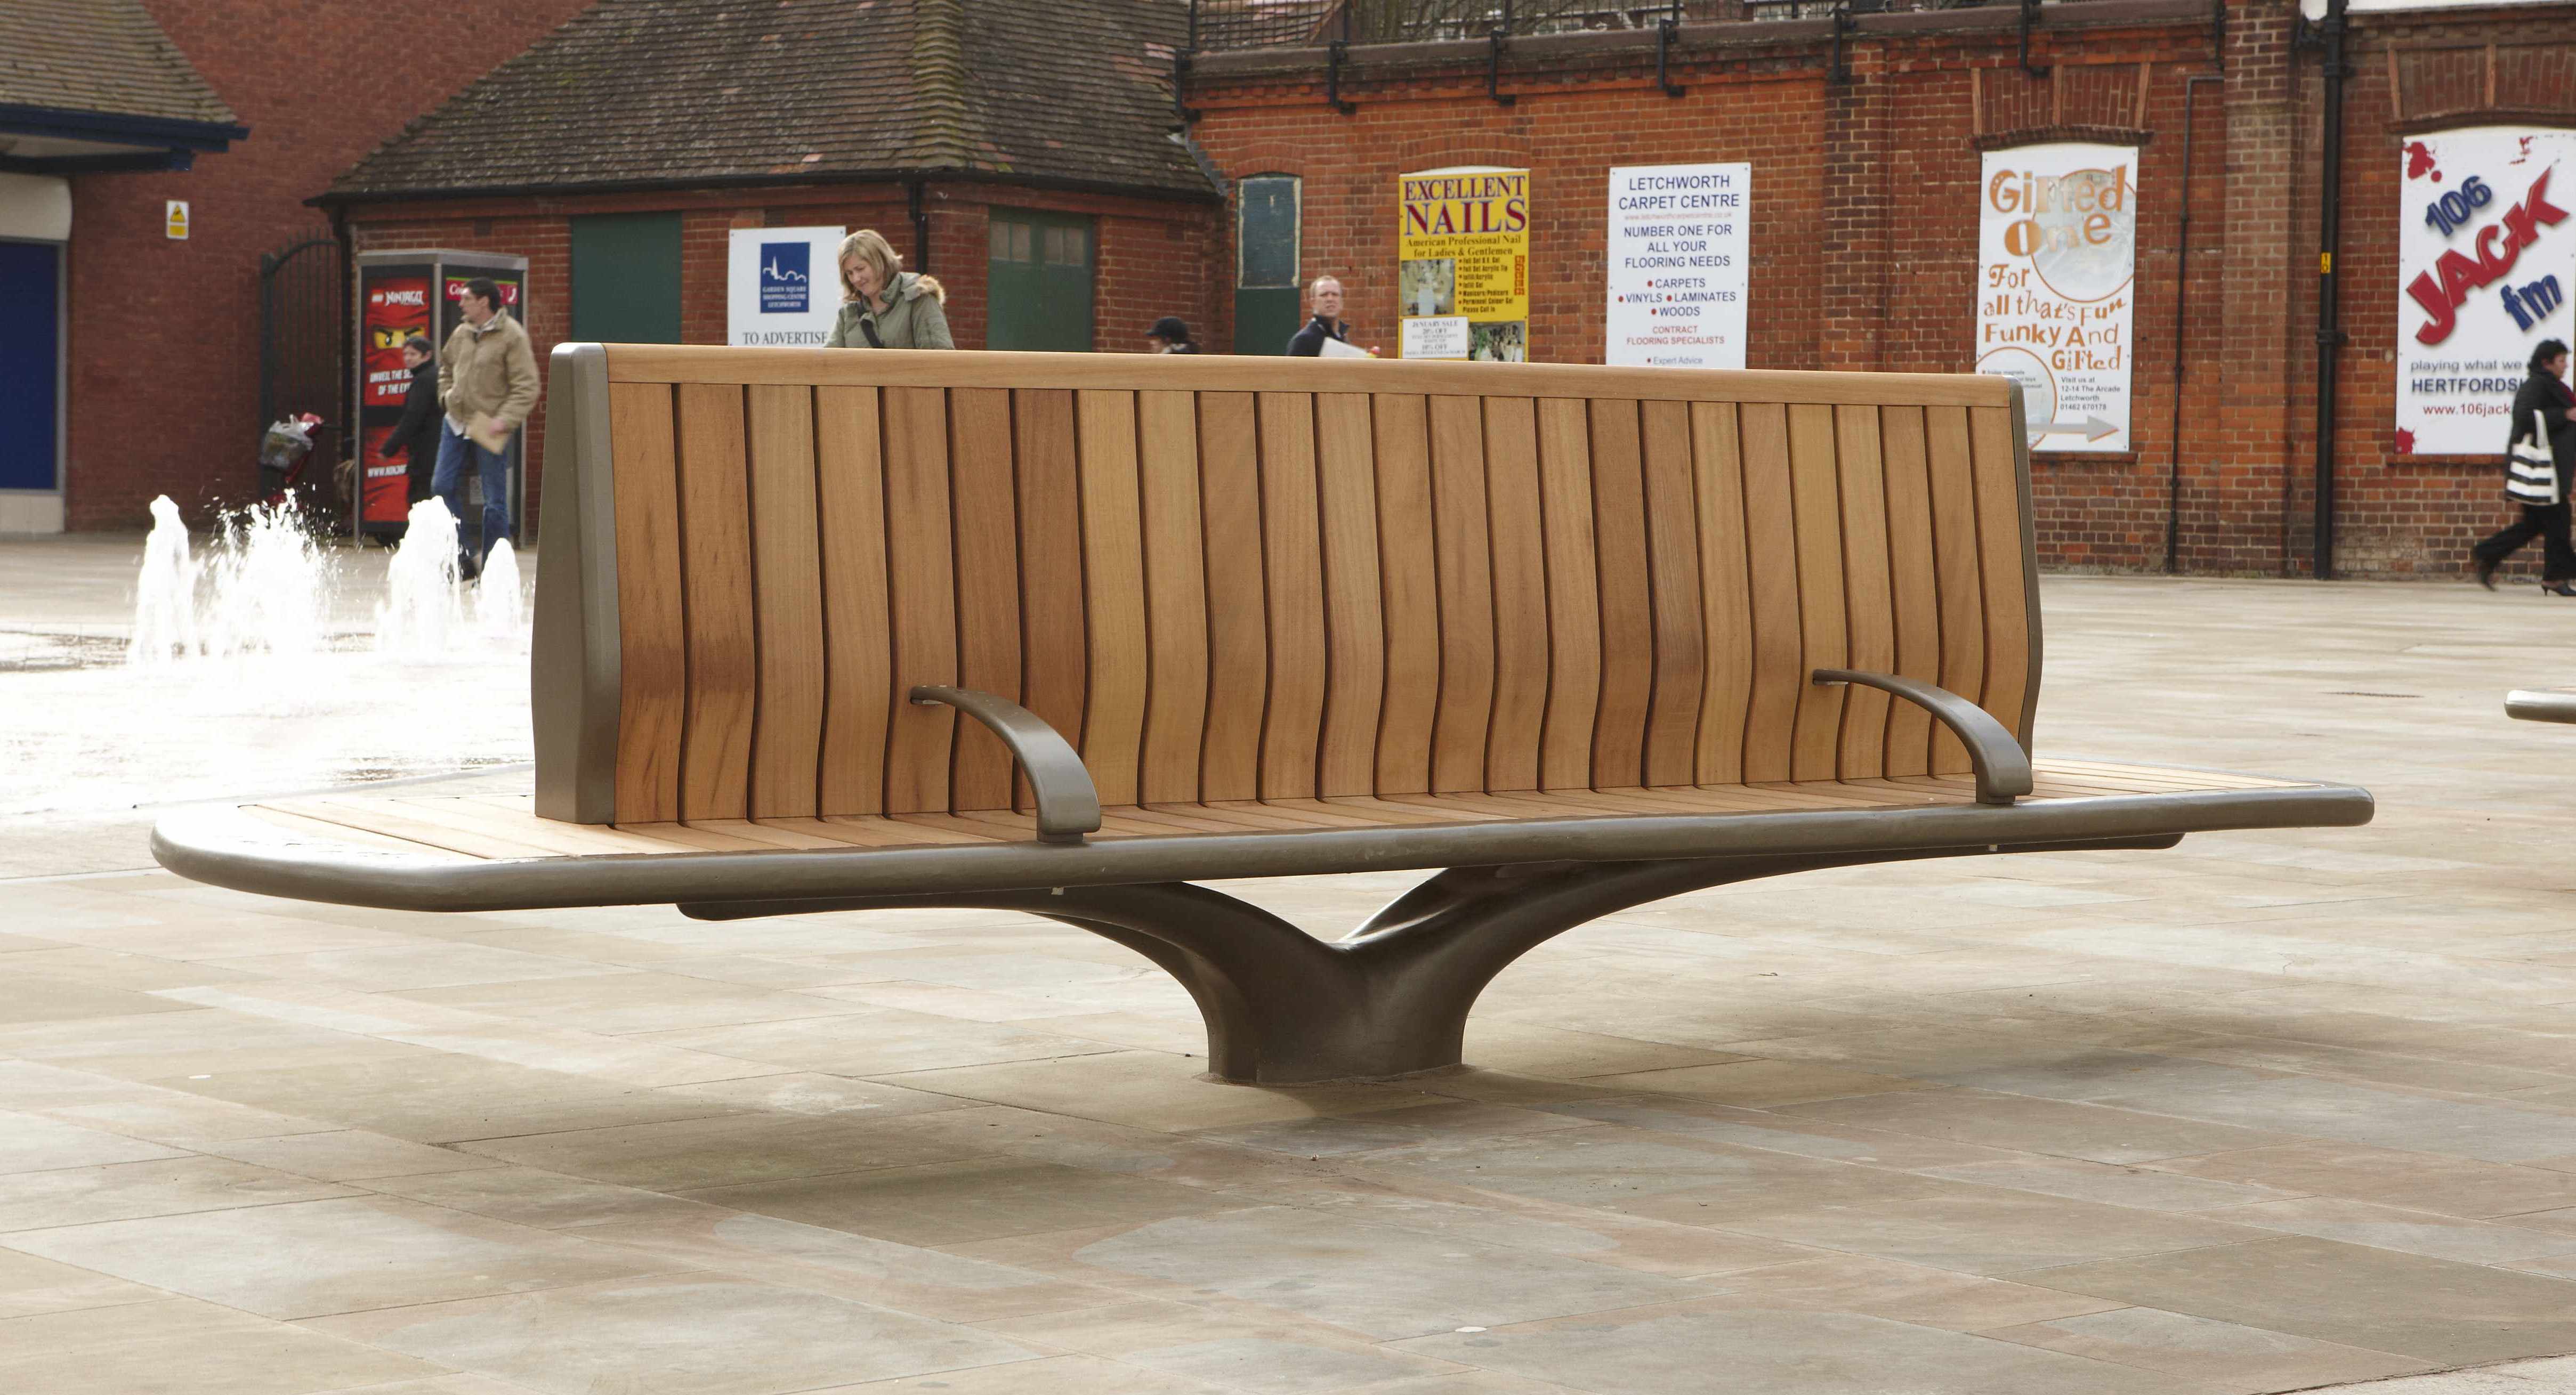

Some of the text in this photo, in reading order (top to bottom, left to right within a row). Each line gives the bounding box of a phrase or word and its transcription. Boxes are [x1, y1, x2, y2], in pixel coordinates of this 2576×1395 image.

[1404, 175, 1526, 201] EXCELLENT
[1629, 174, 1731, 190] LETCHWORTH
[1618, 194, 1740, 210] CARPET CENTRE
[2425, 176, 2492, 237] 106
[1404, 198, 1527, 236] NAILS
[1624, 224, 1732, 237] NUMBER ONE FOR
[1407, 234, 1521, 247] American Professional Nail
[1648, 240, 1707, 252] ALL YOUR
[1414, 247, 1513, 257] for Ladies & Gentlemen
[2405, 165, 2570, 345] JACK
[1625, 255, 1731, 268] FLOORING NEEDS
[1989, 264, 2030, 288] For
[1655, 278, 1706, 289] CARPETS
[1626, 291, 1737, 303] VINYLS LAMINATES
[2500, 274, 2563, 332] fm
[1659, 306, 1700, 317] WOODS
[1984, 289, 2127, 327] all that's Fun
[1652, 326, 1698, 334] CONTRACT
[1985, 322, 2119, 348] Funky And
[743, 331, 828, 345] TO ADVERTISE
[1627, 336, 1725, 345] FLOORING SPECIALISTS
[1653, 356, 1703, 366] Expert Advice
[2410, 360, 2522, 372] playing what we
[2422, 402, 2510, 417] www.106jack
